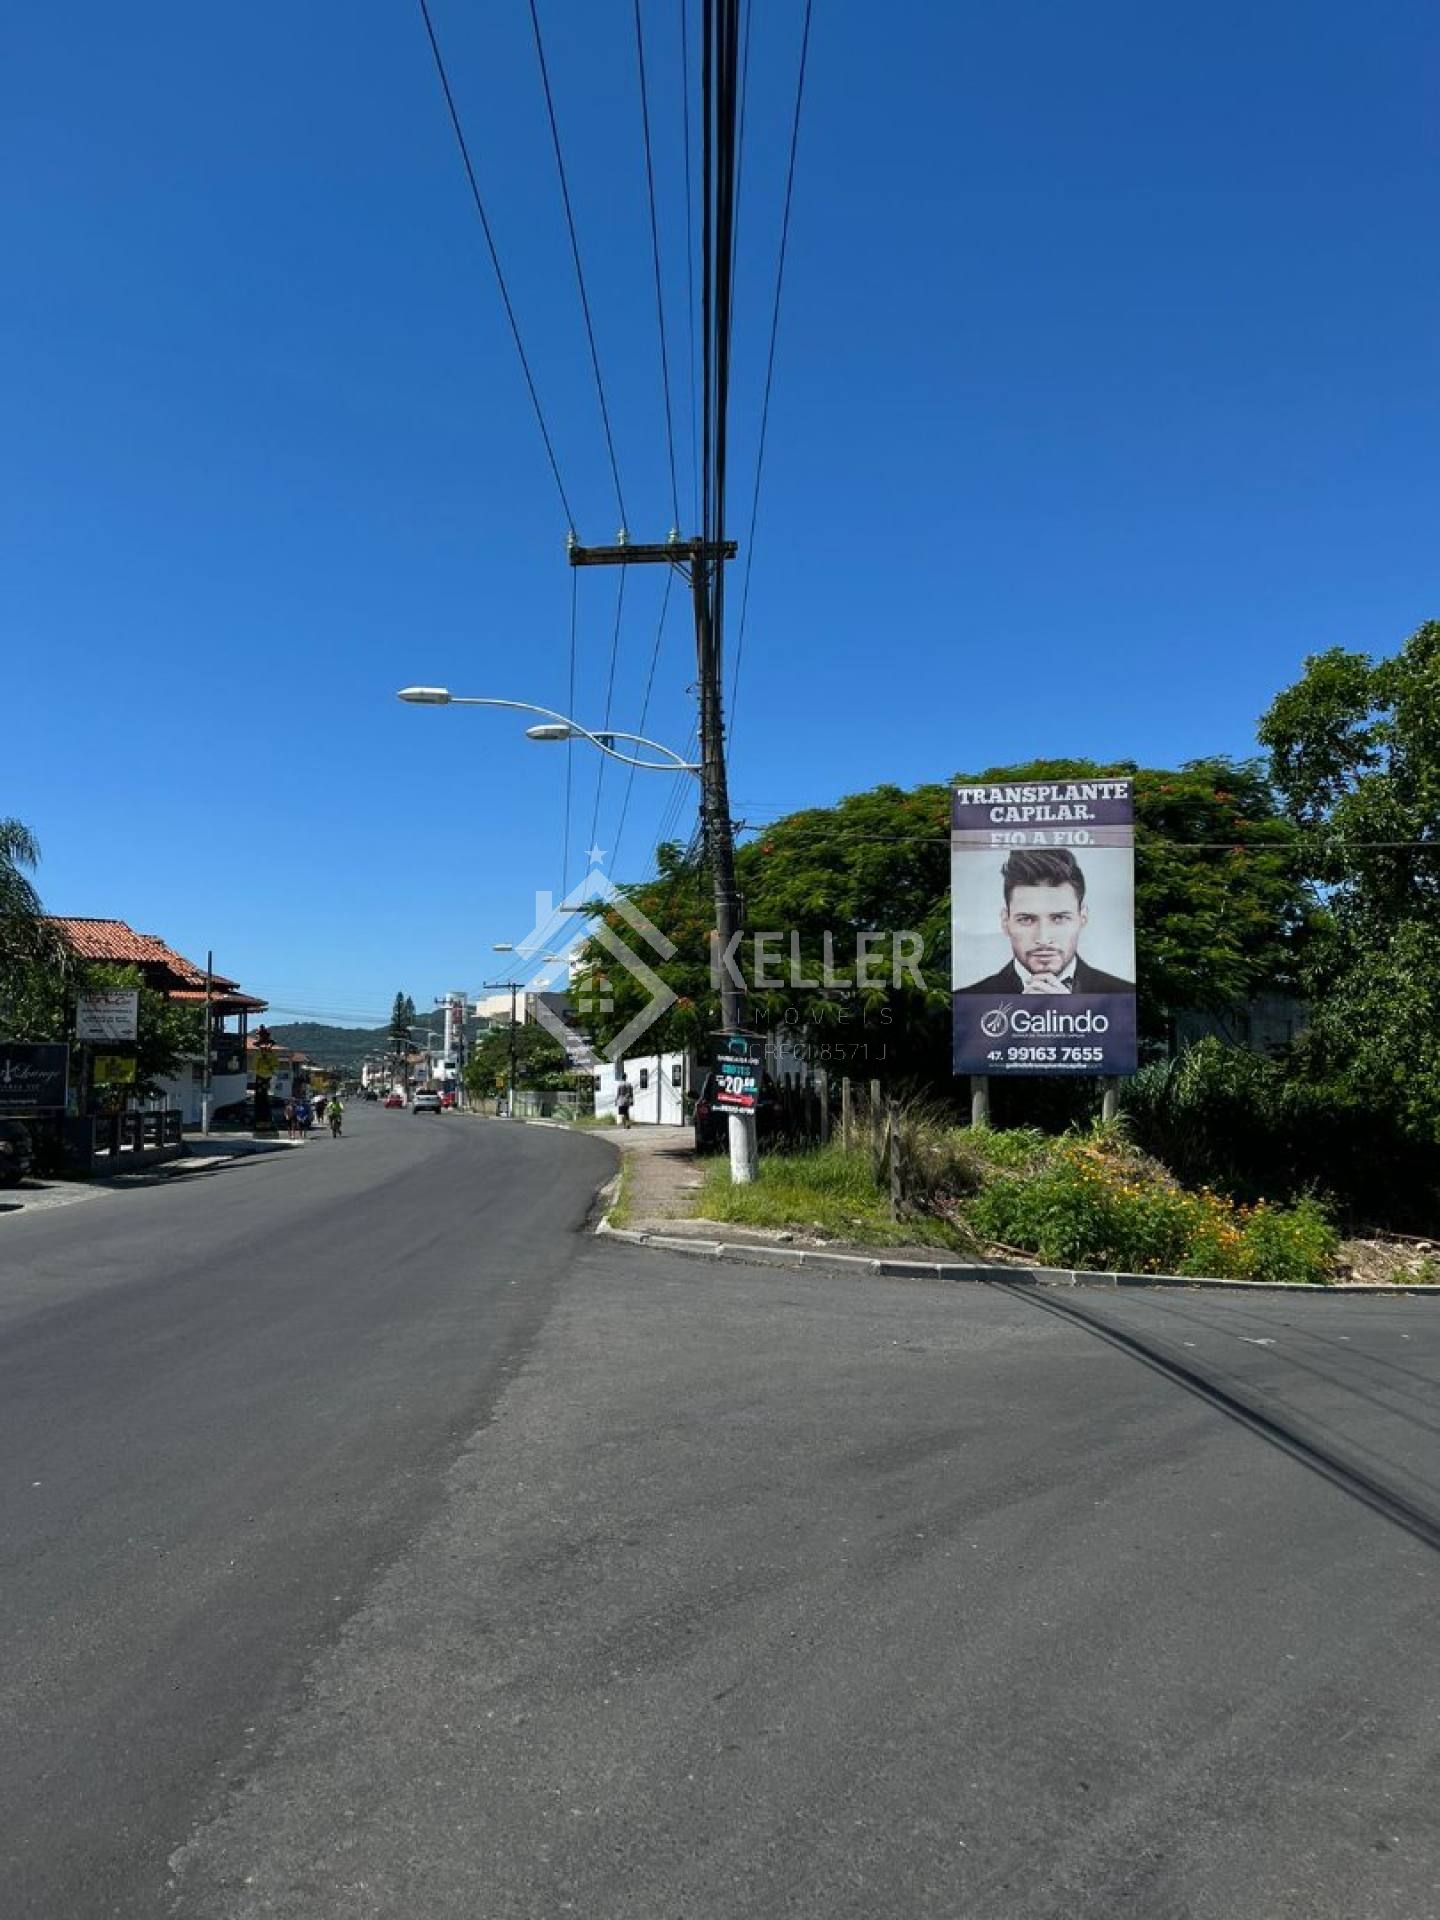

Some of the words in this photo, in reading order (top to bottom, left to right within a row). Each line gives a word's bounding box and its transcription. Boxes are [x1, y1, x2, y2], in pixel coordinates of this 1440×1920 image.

[957, 783, 1128, 805] TRANSPLANTE
[989, 804, 1096, 823] CAPILAR.
[991, 831, 1027, 848] FIO
[1033, 831, 1047, 846] A
[1011, 1009, 1109, 1033] Galindo
[1007, 1046, 1057, 1062] 99163
[1060, 1046, 1104, 1062] 7655
